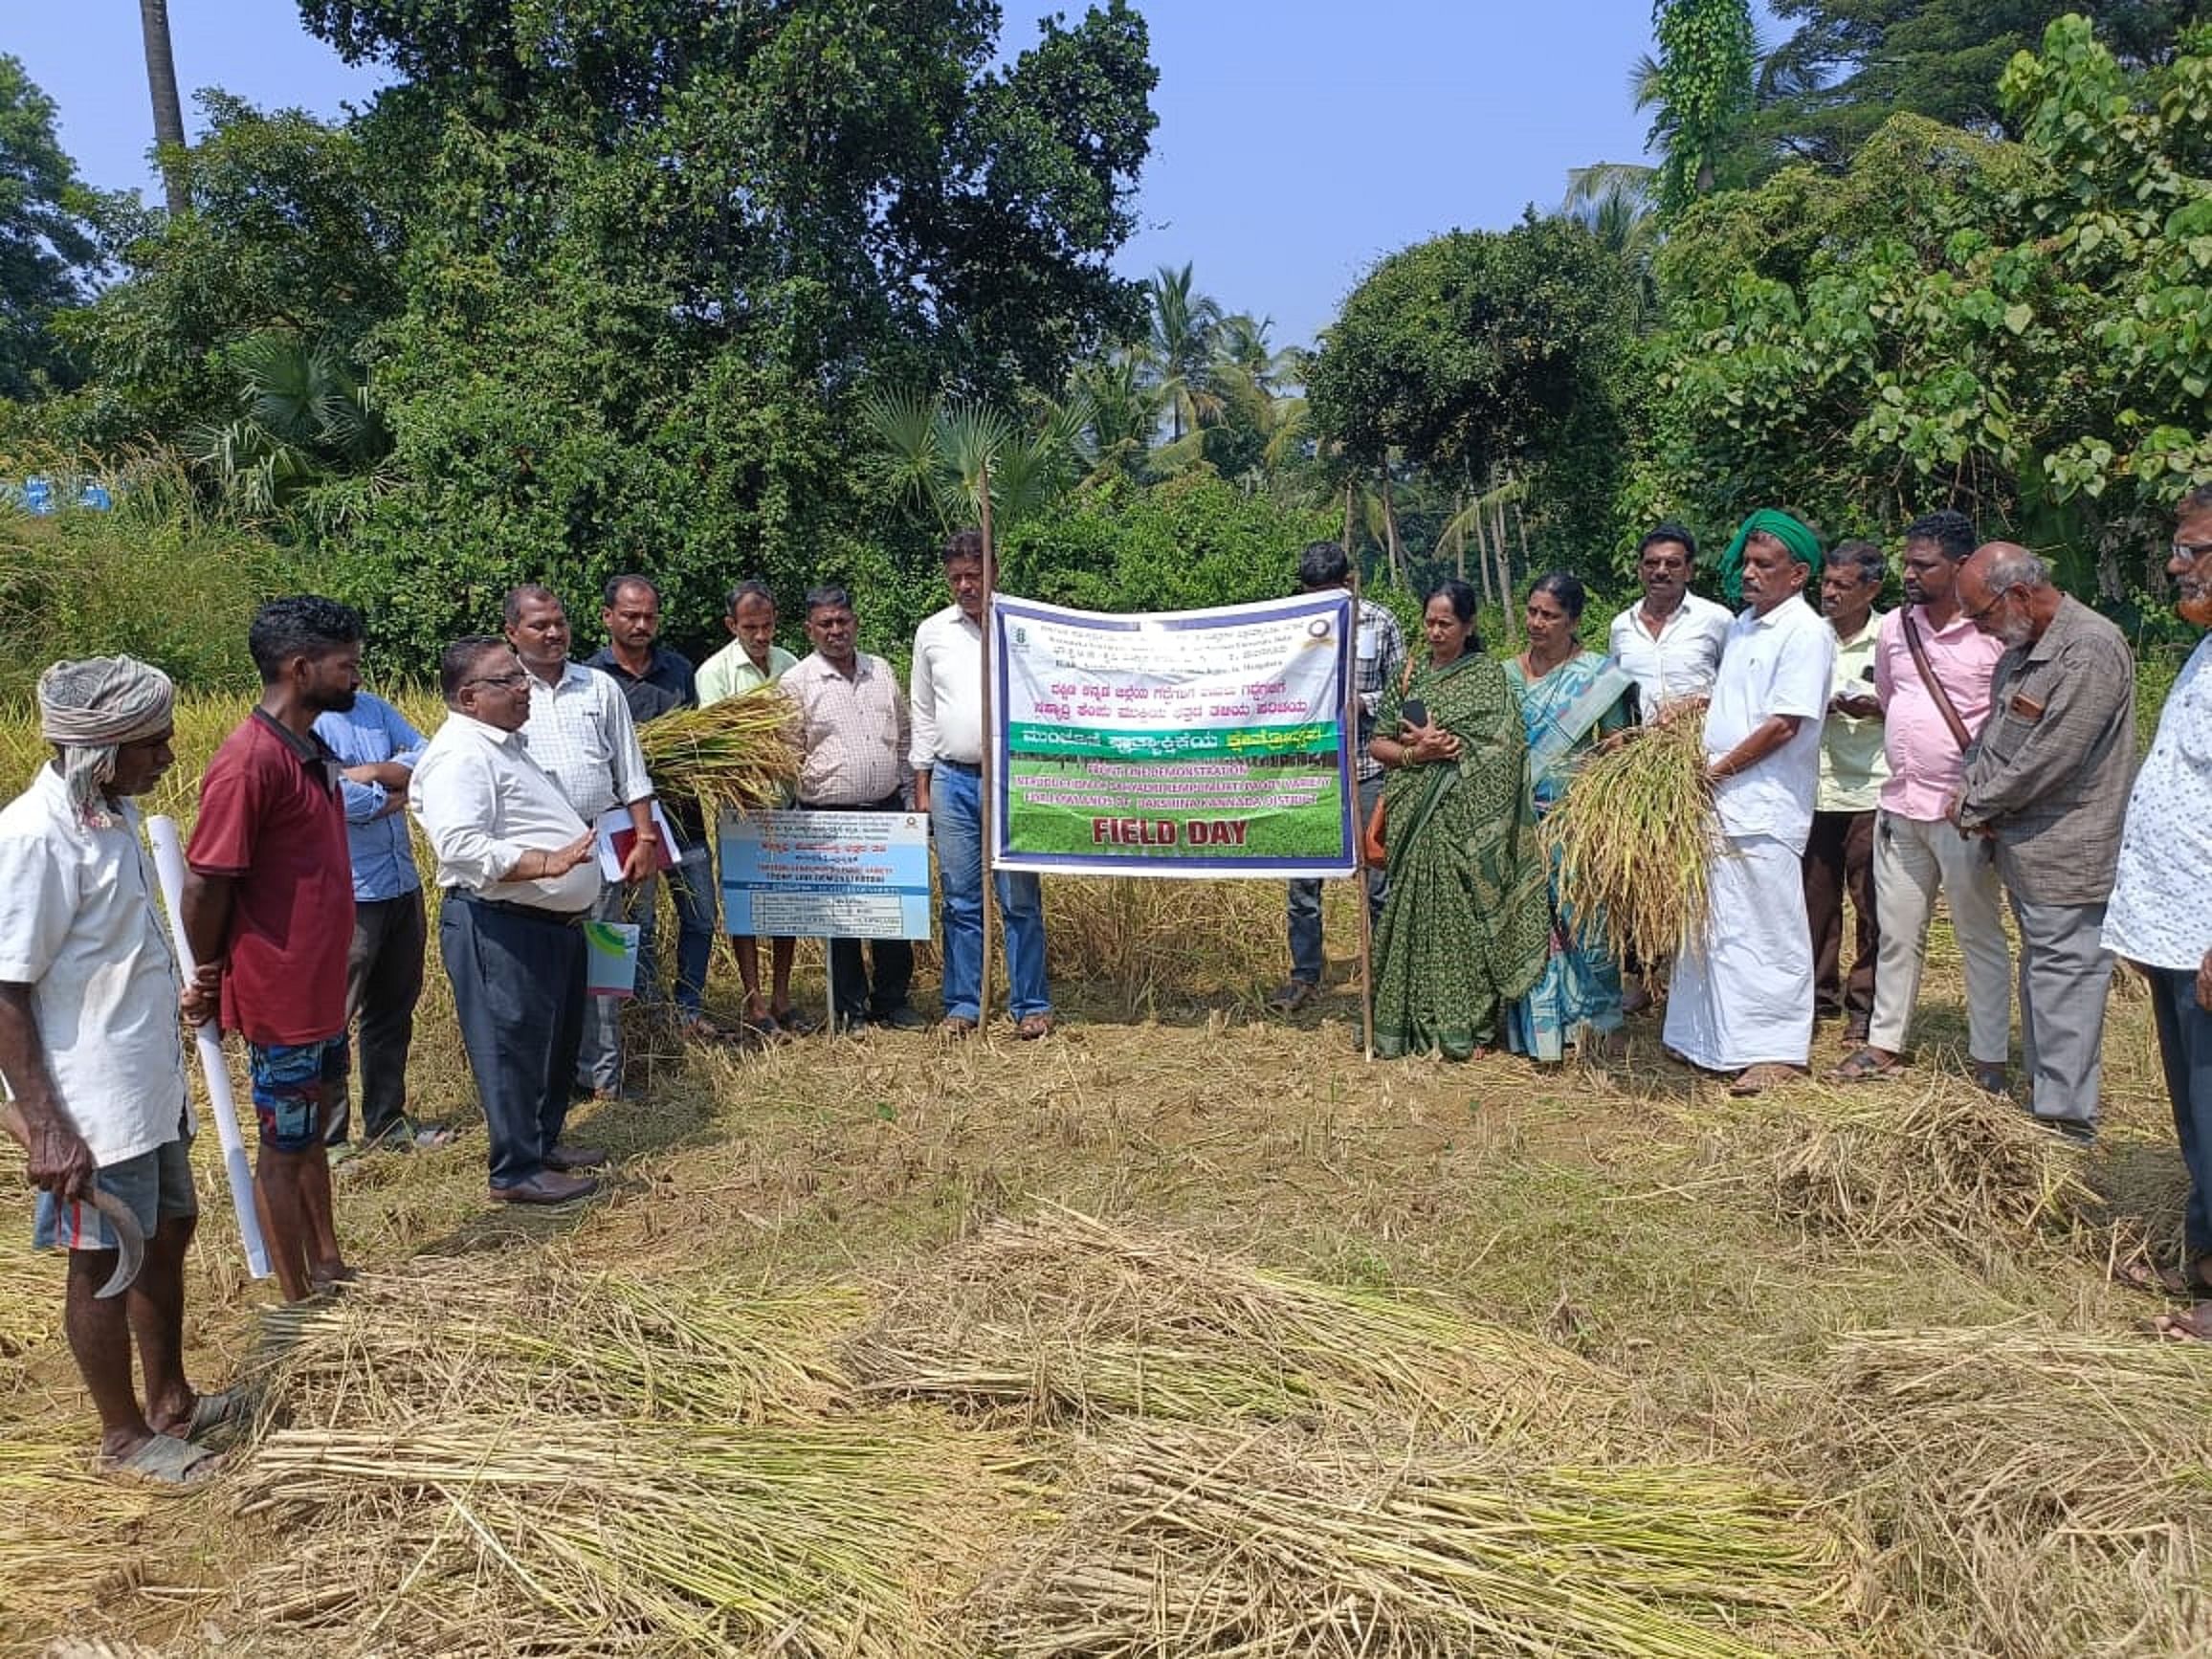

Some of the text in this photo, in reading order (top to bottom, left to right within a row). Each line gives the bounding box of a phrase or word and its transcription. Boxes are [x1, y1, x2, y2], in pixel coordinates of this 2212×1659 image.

[1151, 763, 1248, 779] DEMONSTRATION
[1093, 817, 1250, 847] FIELD DAY
